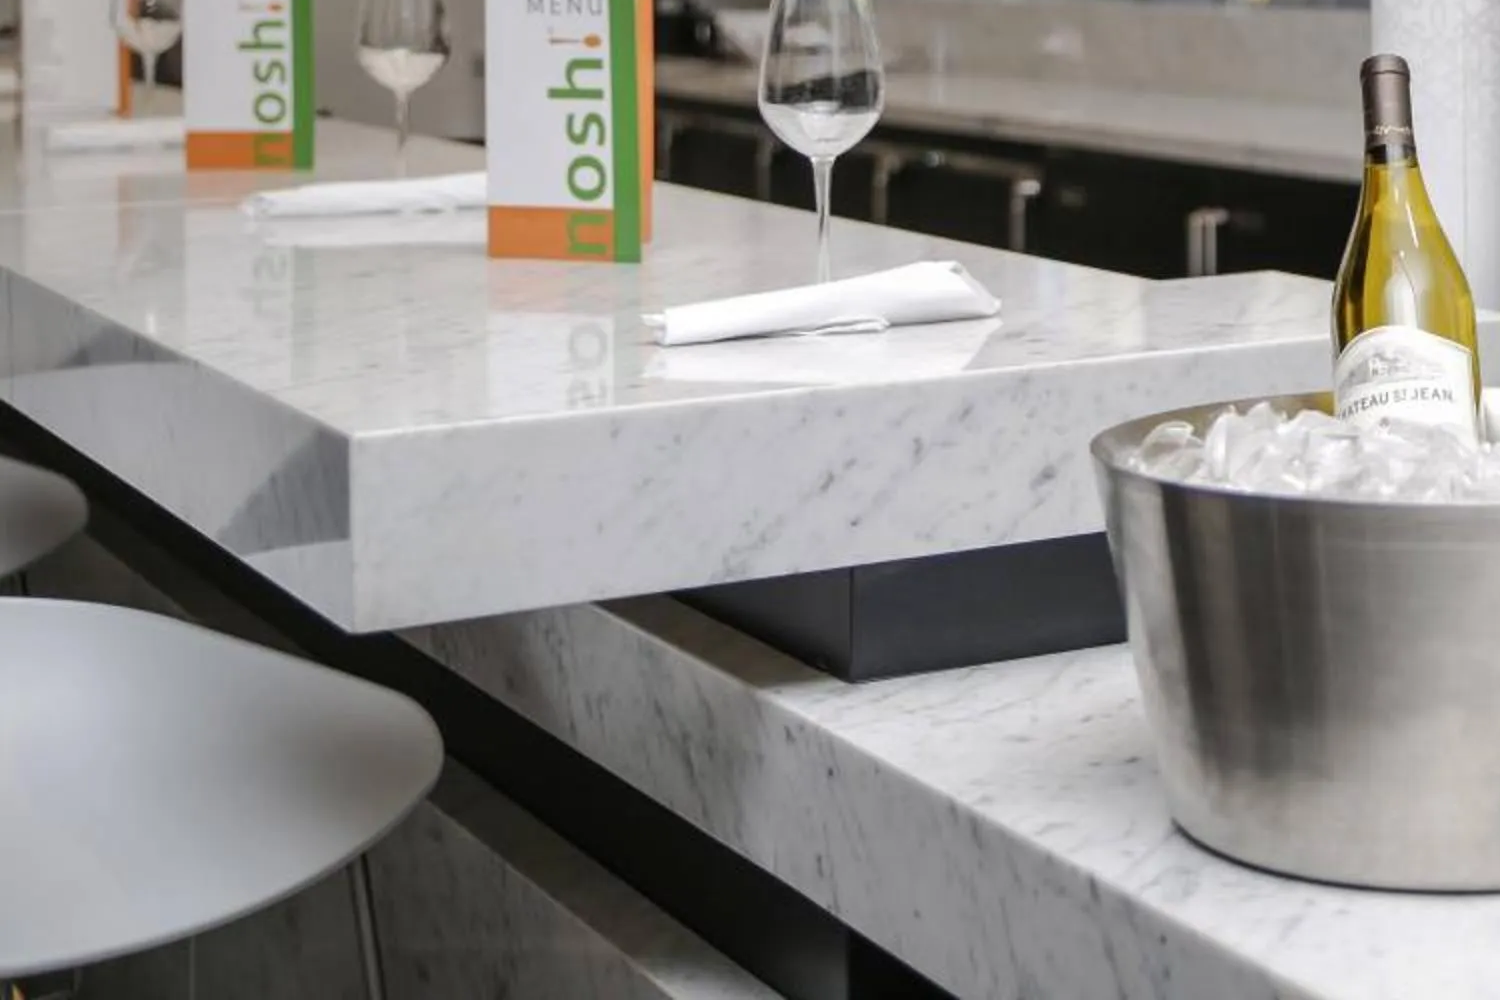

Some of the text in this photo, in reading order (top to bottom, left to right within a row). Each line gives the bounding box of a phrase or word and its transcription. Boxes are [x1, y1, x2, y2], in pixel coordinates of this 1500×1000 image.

[237, 19, 286, 167] nosh
[547, 58, 608, 256] nosh
[1336, 391, 1389, 421] HATEAU
[1411, 386, 1454, 403] JEAN
